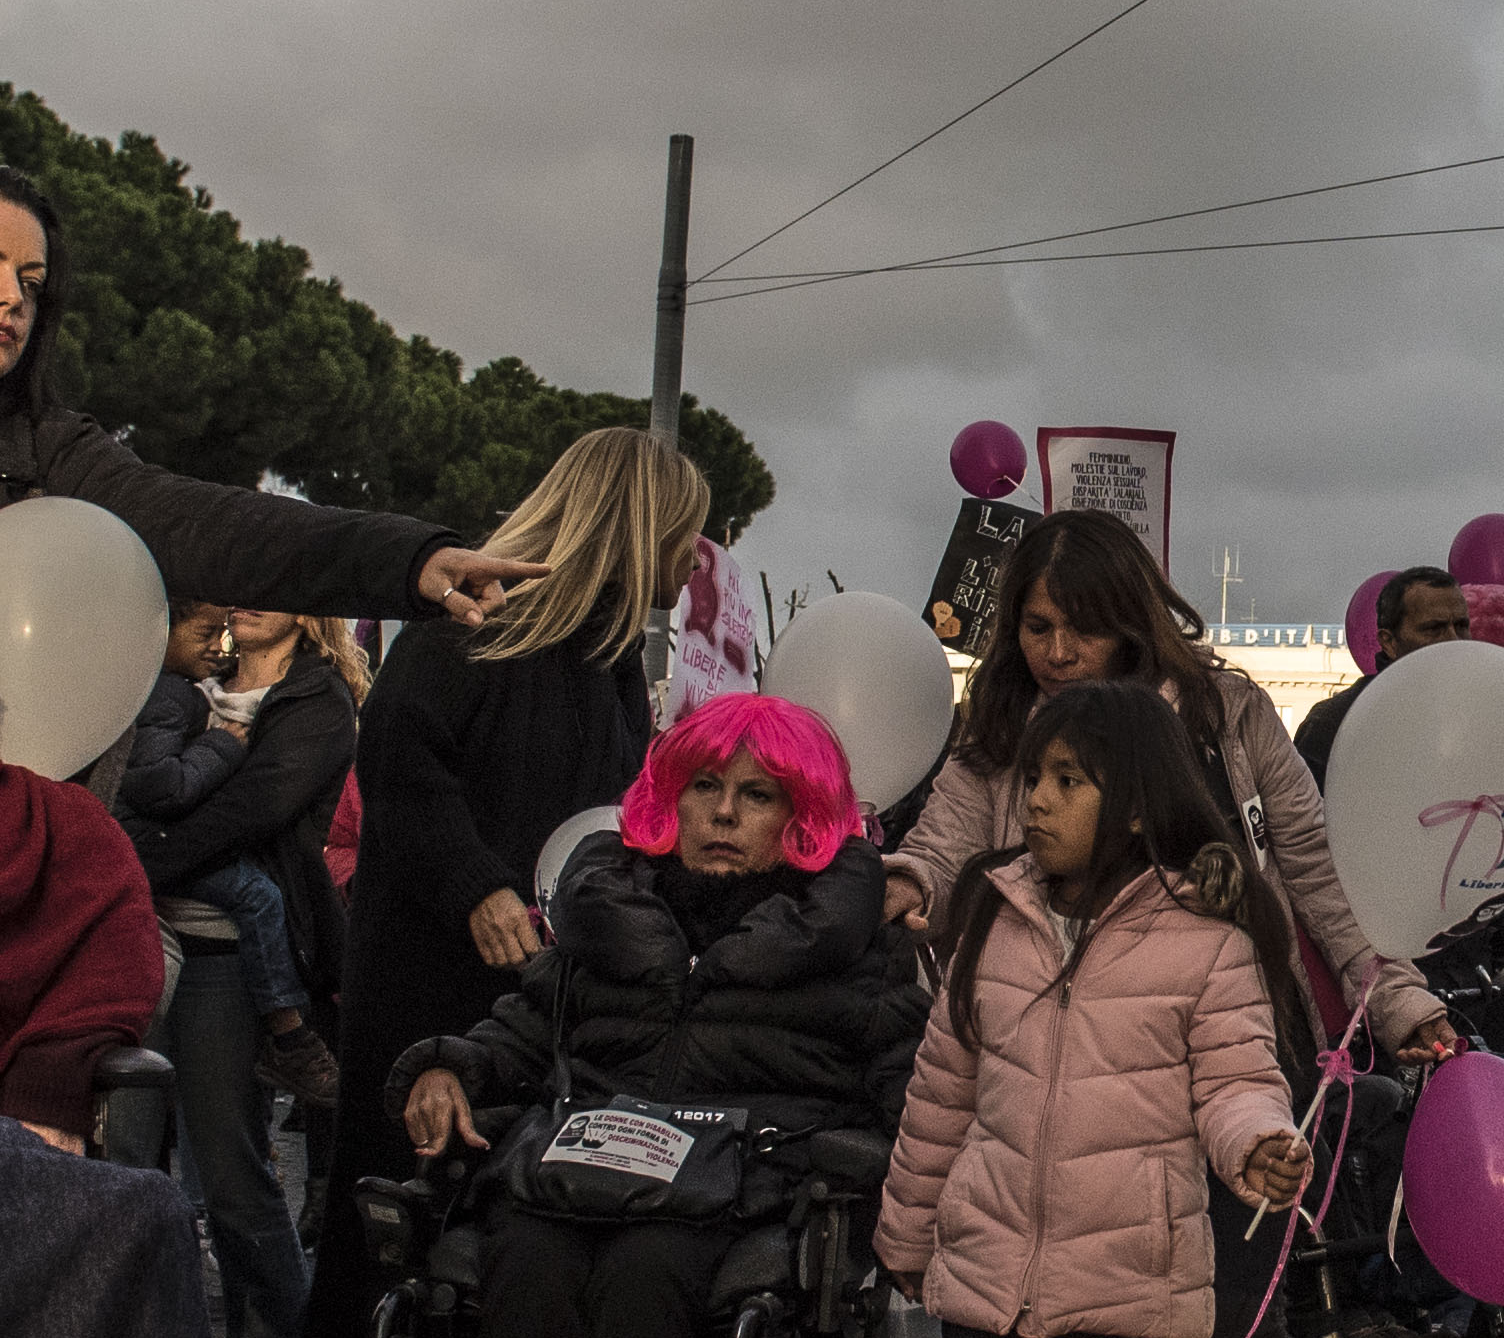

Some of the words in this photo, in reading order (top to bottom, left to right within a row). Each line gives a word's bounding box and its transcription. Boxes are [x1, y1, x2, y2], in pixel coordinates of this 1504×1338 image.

[604, 1114, 628, 1124] DONNE
[636, 1128, 660, 1143] FORMA
[607, 1133, 669, 1156] DISCRIMINAZIONE
[646, 1151, 680, 1169] VIOLENZA
